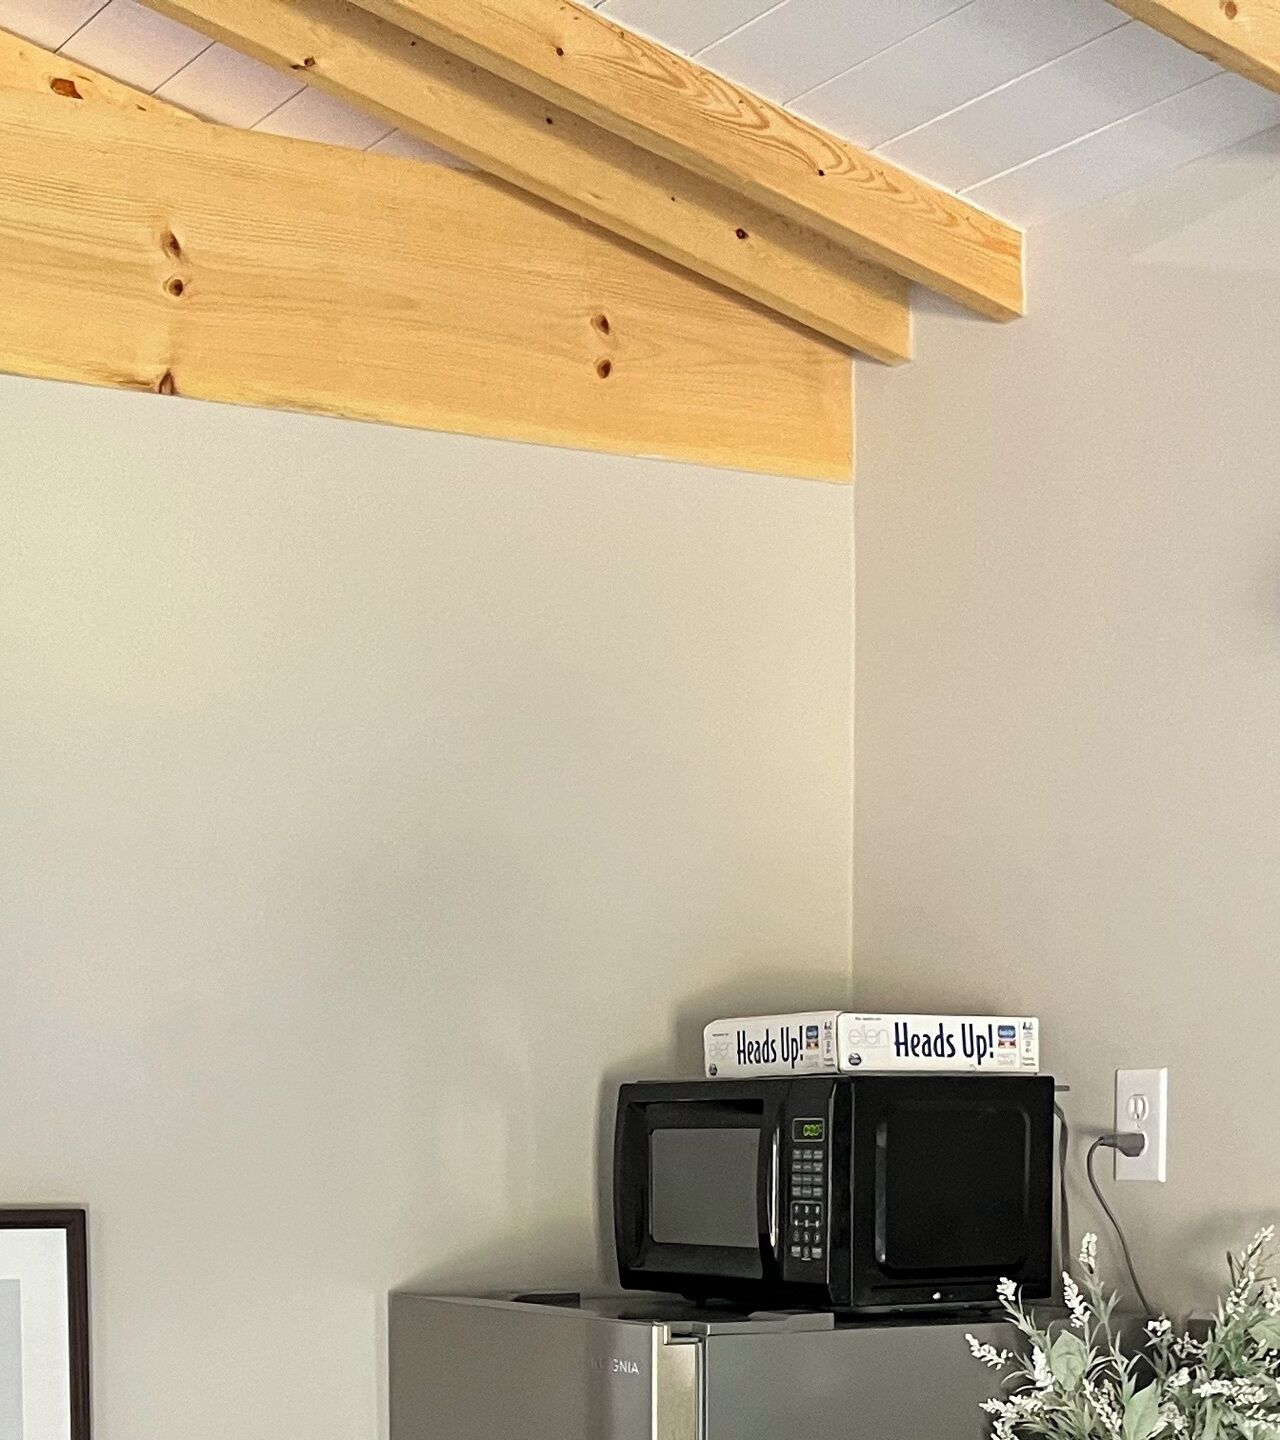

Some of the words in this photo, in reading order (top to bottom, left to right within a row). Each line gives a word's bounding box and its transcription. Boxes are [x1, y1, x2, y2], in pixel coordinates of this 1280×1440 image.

[737, 1028, 777, 1065] Heads
[780, 1025, 804, 1069] Up!
[894, 1021, 956, 1058] Heads
[961, 1023, 994, 1066] Up!
